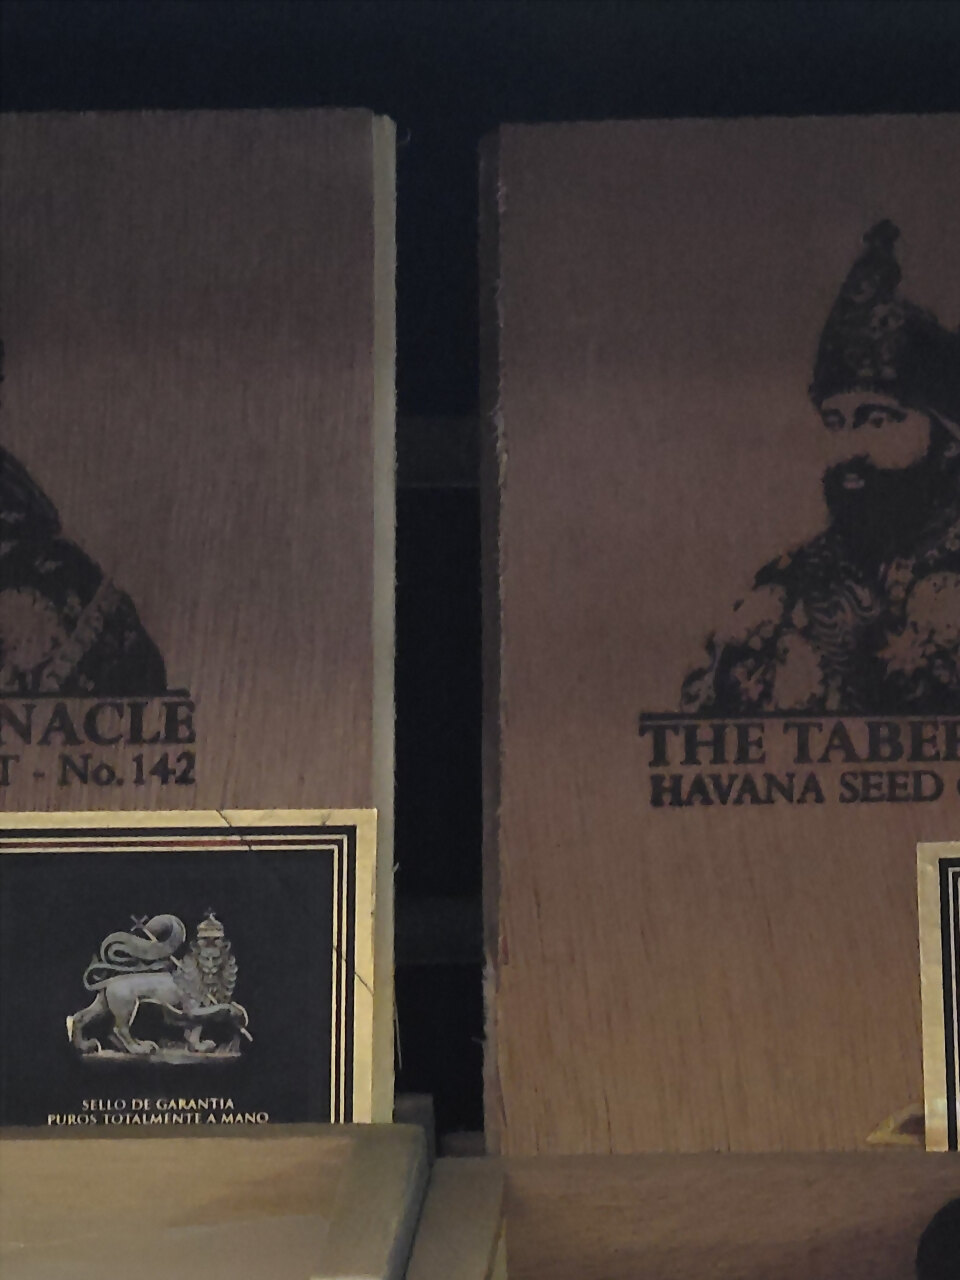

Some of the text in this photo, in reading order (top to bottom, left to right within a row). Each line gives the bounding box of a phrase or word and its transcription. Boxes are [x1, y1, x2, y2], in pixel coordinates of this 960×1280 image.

[0, 700, 196, 745] NACLE
[638, 719, 766, 767] THE
[57, 750, 196, 786] No.142
[650, 772, 826, 806] HAVANA
[839, 769, 944, 803] SEED
[47, 1111, 269, 1126] PUROS TOTALMENTE A MANO
[81, 1099, 126, 1112] SELLO
[131, 1099, 150, 1111] DE
